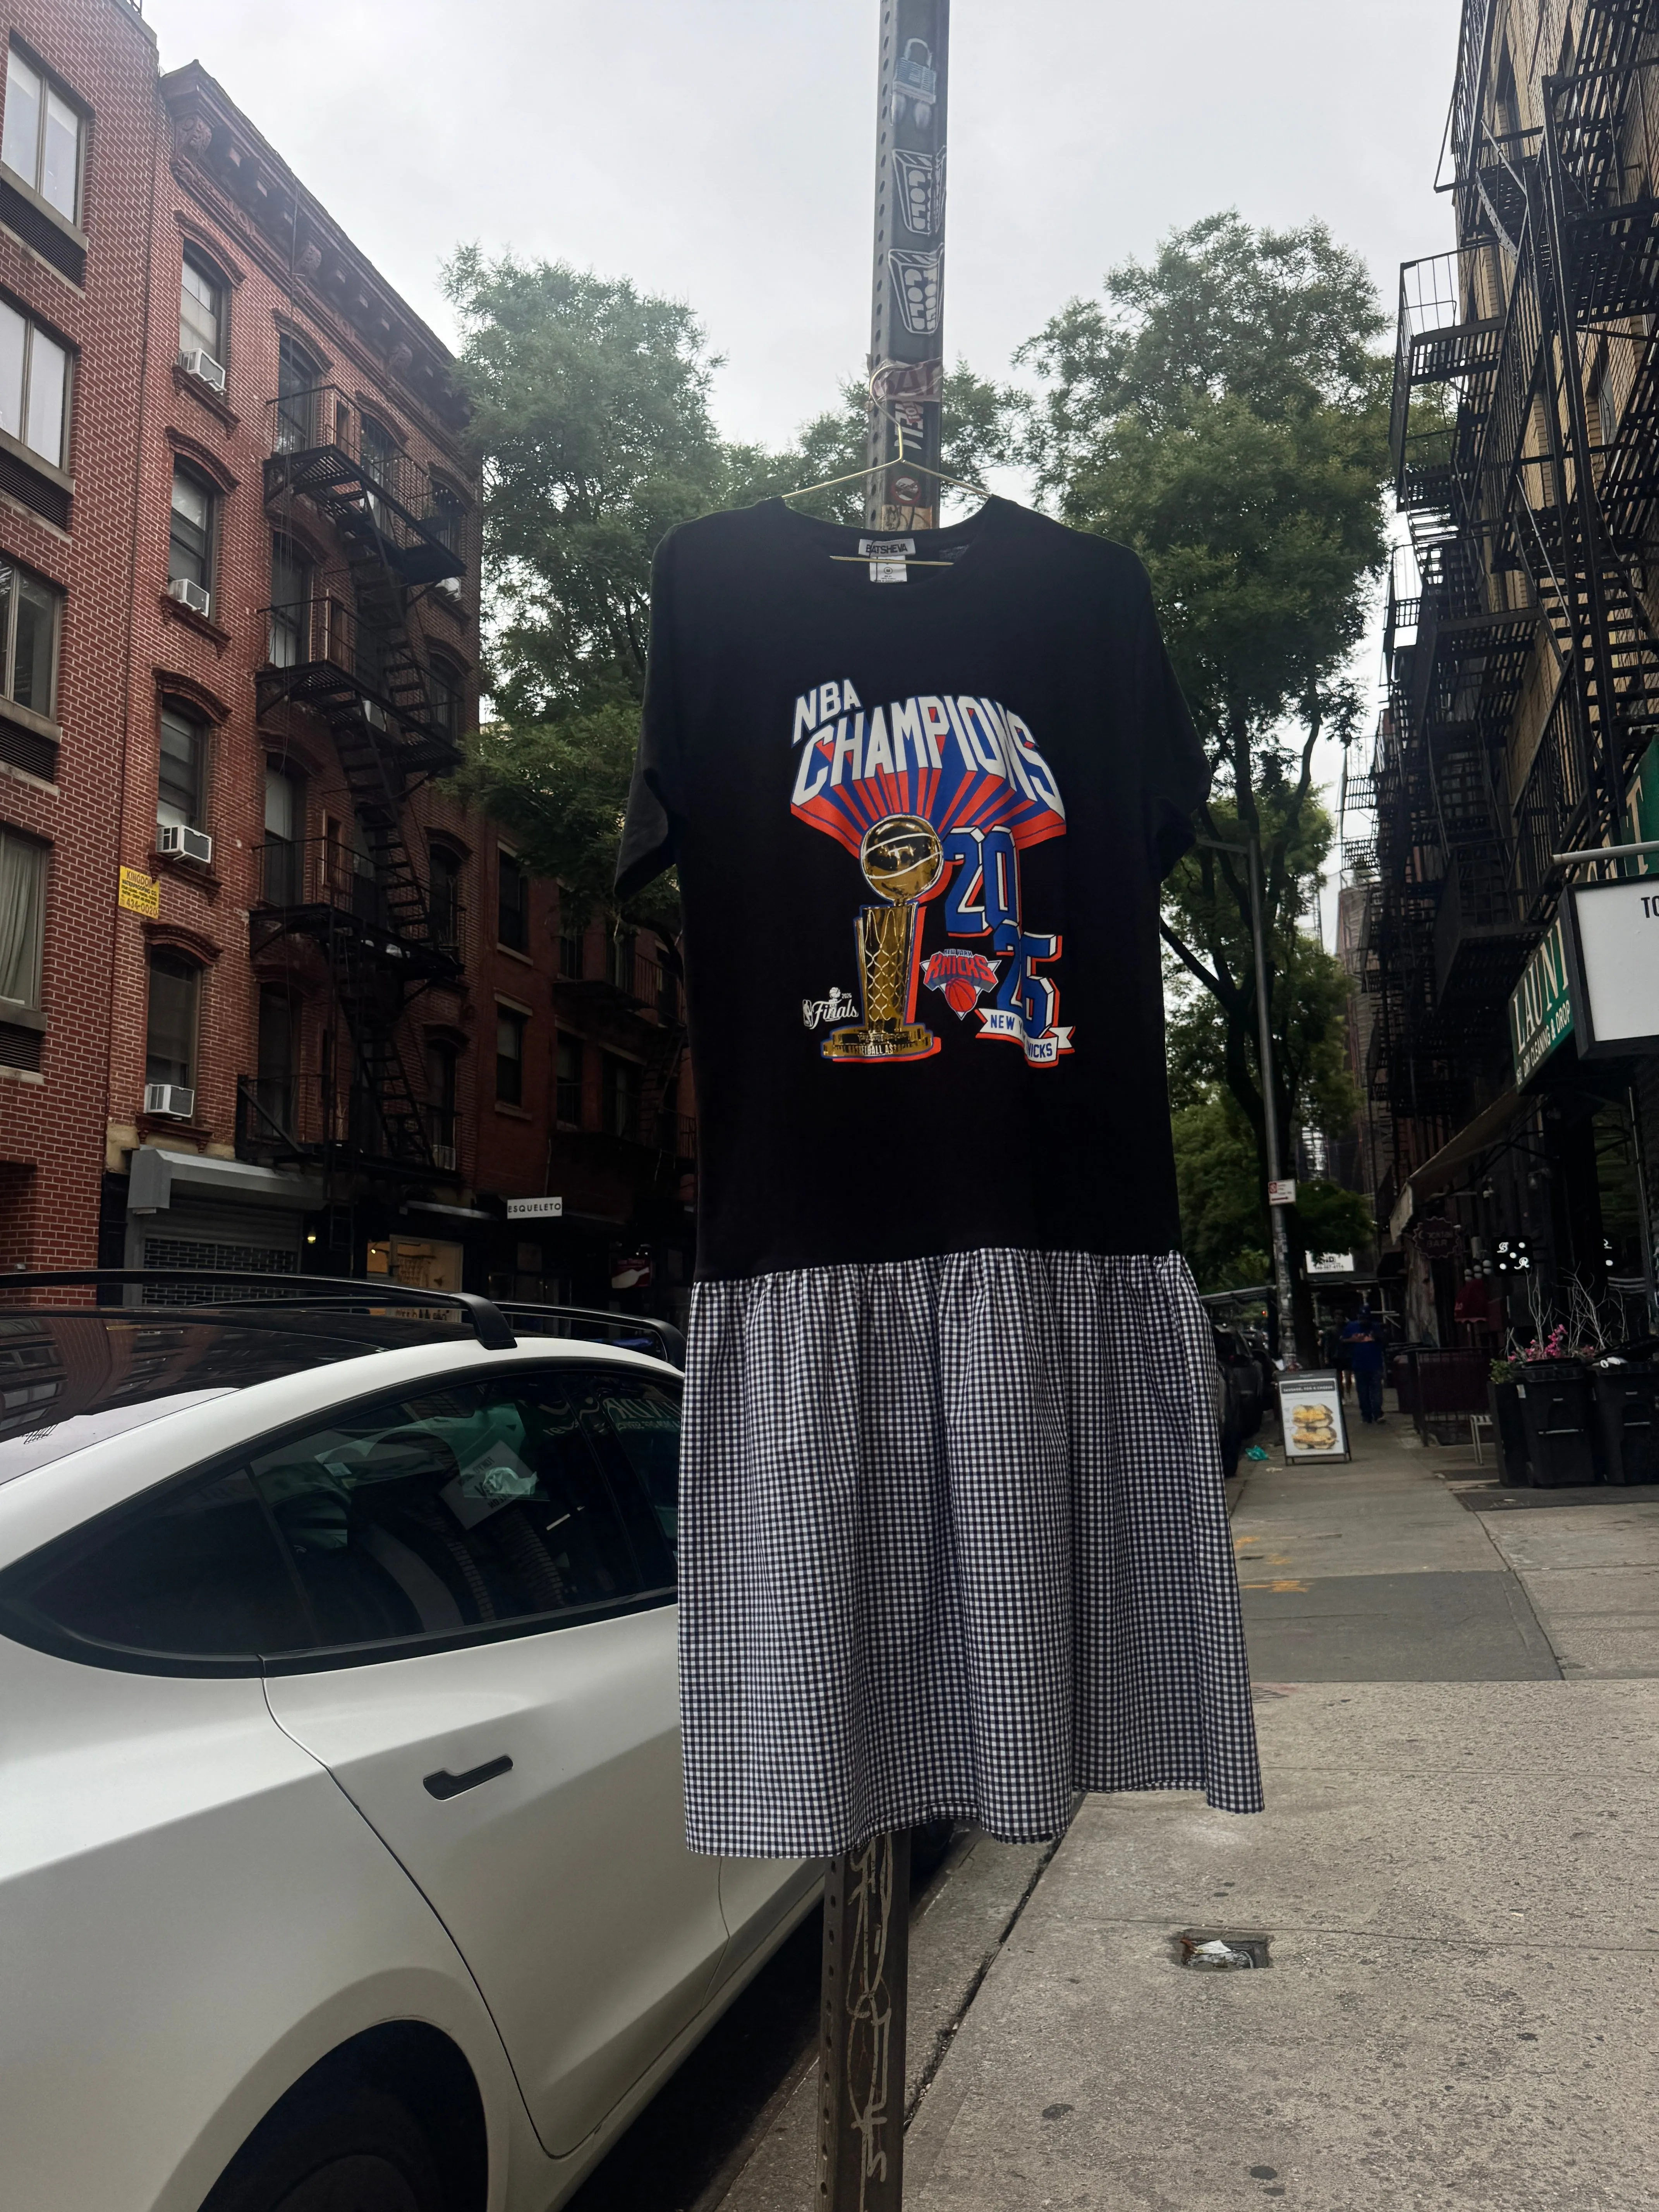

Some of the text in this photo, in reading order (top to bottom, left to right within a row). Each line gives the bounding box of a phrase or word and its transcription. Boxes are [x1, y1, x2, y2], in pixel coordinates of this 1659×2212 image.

[866, 543, 908, 554] BATSHEVA
[792, 678, 862, 744] NBA
[791, 696, 1066, 821] CHAMPIONS
[943, 826, 1019, 934] 20
[924, 953, 998, 984] KNICKS
[993, 919, 1057, 1038] 26
[809, 999, 859, 1030] Finals
[991, 1015, 1015, 1030] NEW
[1530, 1025, 1551, 1067] CLEANING
[1551, 1018, 1556, 1041] &
[1556, 1000, 1570, 1034] DROP
[1027, 1042, 1053, 1058] NICKS
[508, 1203, 561, 1213] ESQUELETO
